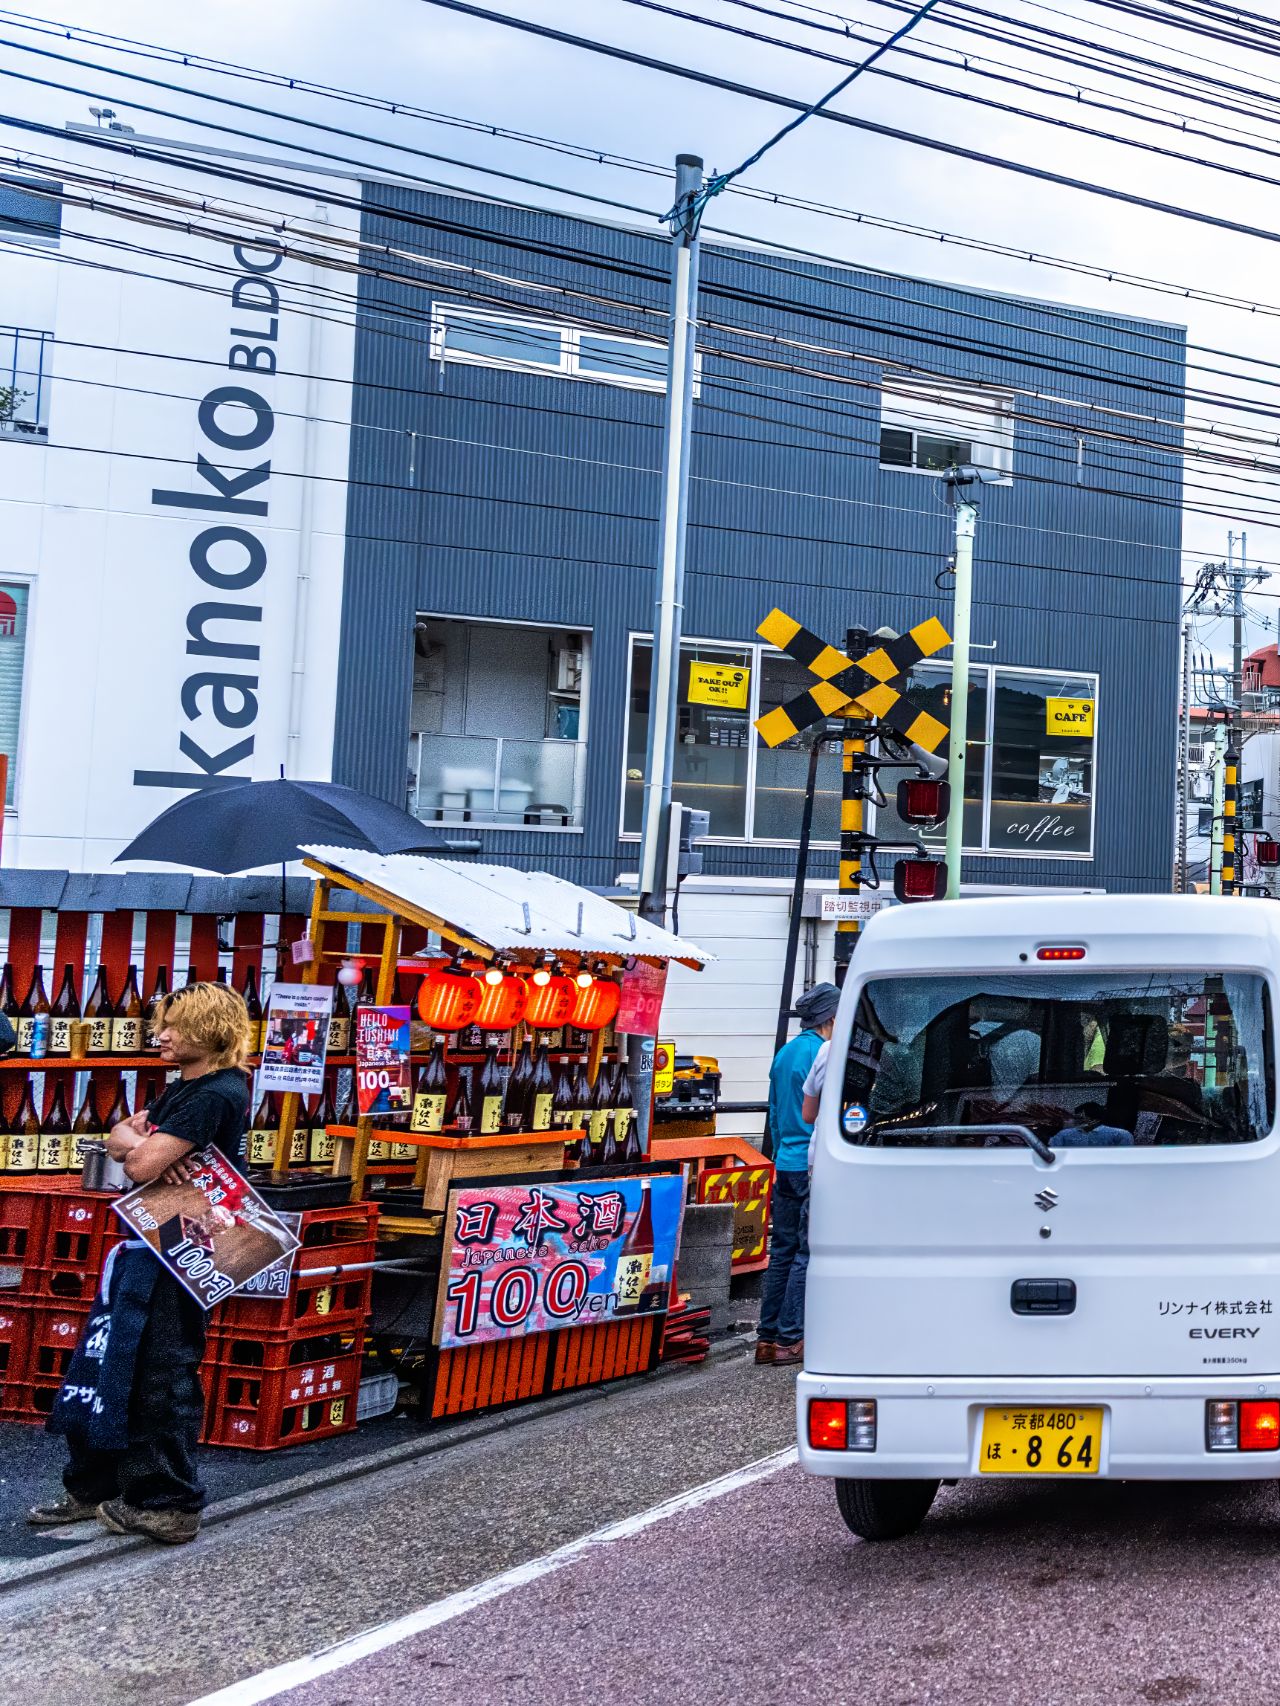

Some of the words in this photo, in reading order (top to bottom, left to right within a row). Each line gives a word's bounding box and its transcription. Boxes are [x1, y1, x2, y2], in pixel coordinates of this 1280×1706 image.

[133, 385, 274, 789] kanoko
[698, 677, 721, 686] TAKE
[1055, 713, 1087, 722] CAFE
[1006, 815, 1075, 841] coffee
[360, 1014, 388, 1027] HELLO
[358, 1070, 390, 1090] 100
[456, 1190, 625, 1243] 日本酒
[168, 1238, 234, 1302] 100円
[239, 1269, 288, 1293] 00円
[448, 1259, 589, 1337] 100
[572, 1291, 619, 1321] yen
[1159, 1300, 1273, 1316] リンナイ株式会社
[1189, 1327, 1261, 1339] EVERY
[300, 1364, 336, 1384] 清酒
[987, 1443, 1001, 1460] ほ
